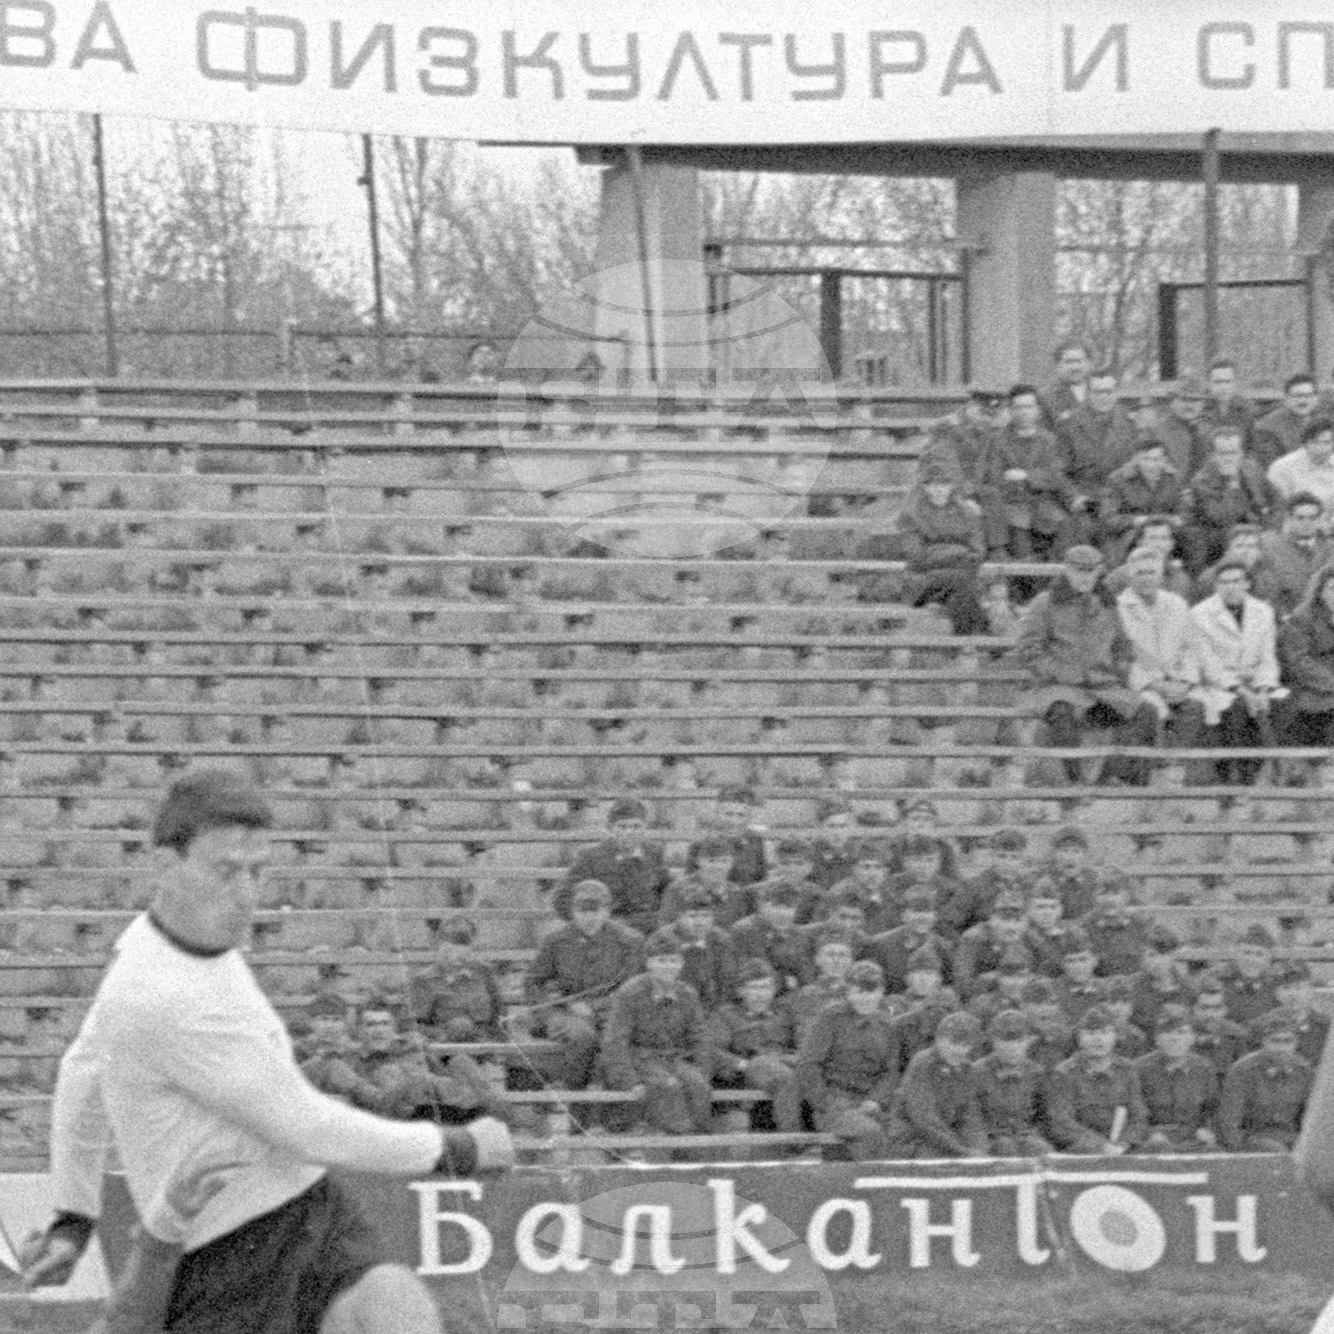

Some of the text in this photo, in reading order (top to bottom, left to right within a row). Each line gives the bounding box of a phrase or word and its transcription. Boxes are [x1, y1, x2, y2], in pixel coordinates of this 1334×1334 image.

[195, 6, 1005, 102] ФИЗКУЛТУРА
[1059, 22, 1130, 94] И
[407, 1171, 1268, 1275] Балкантон
